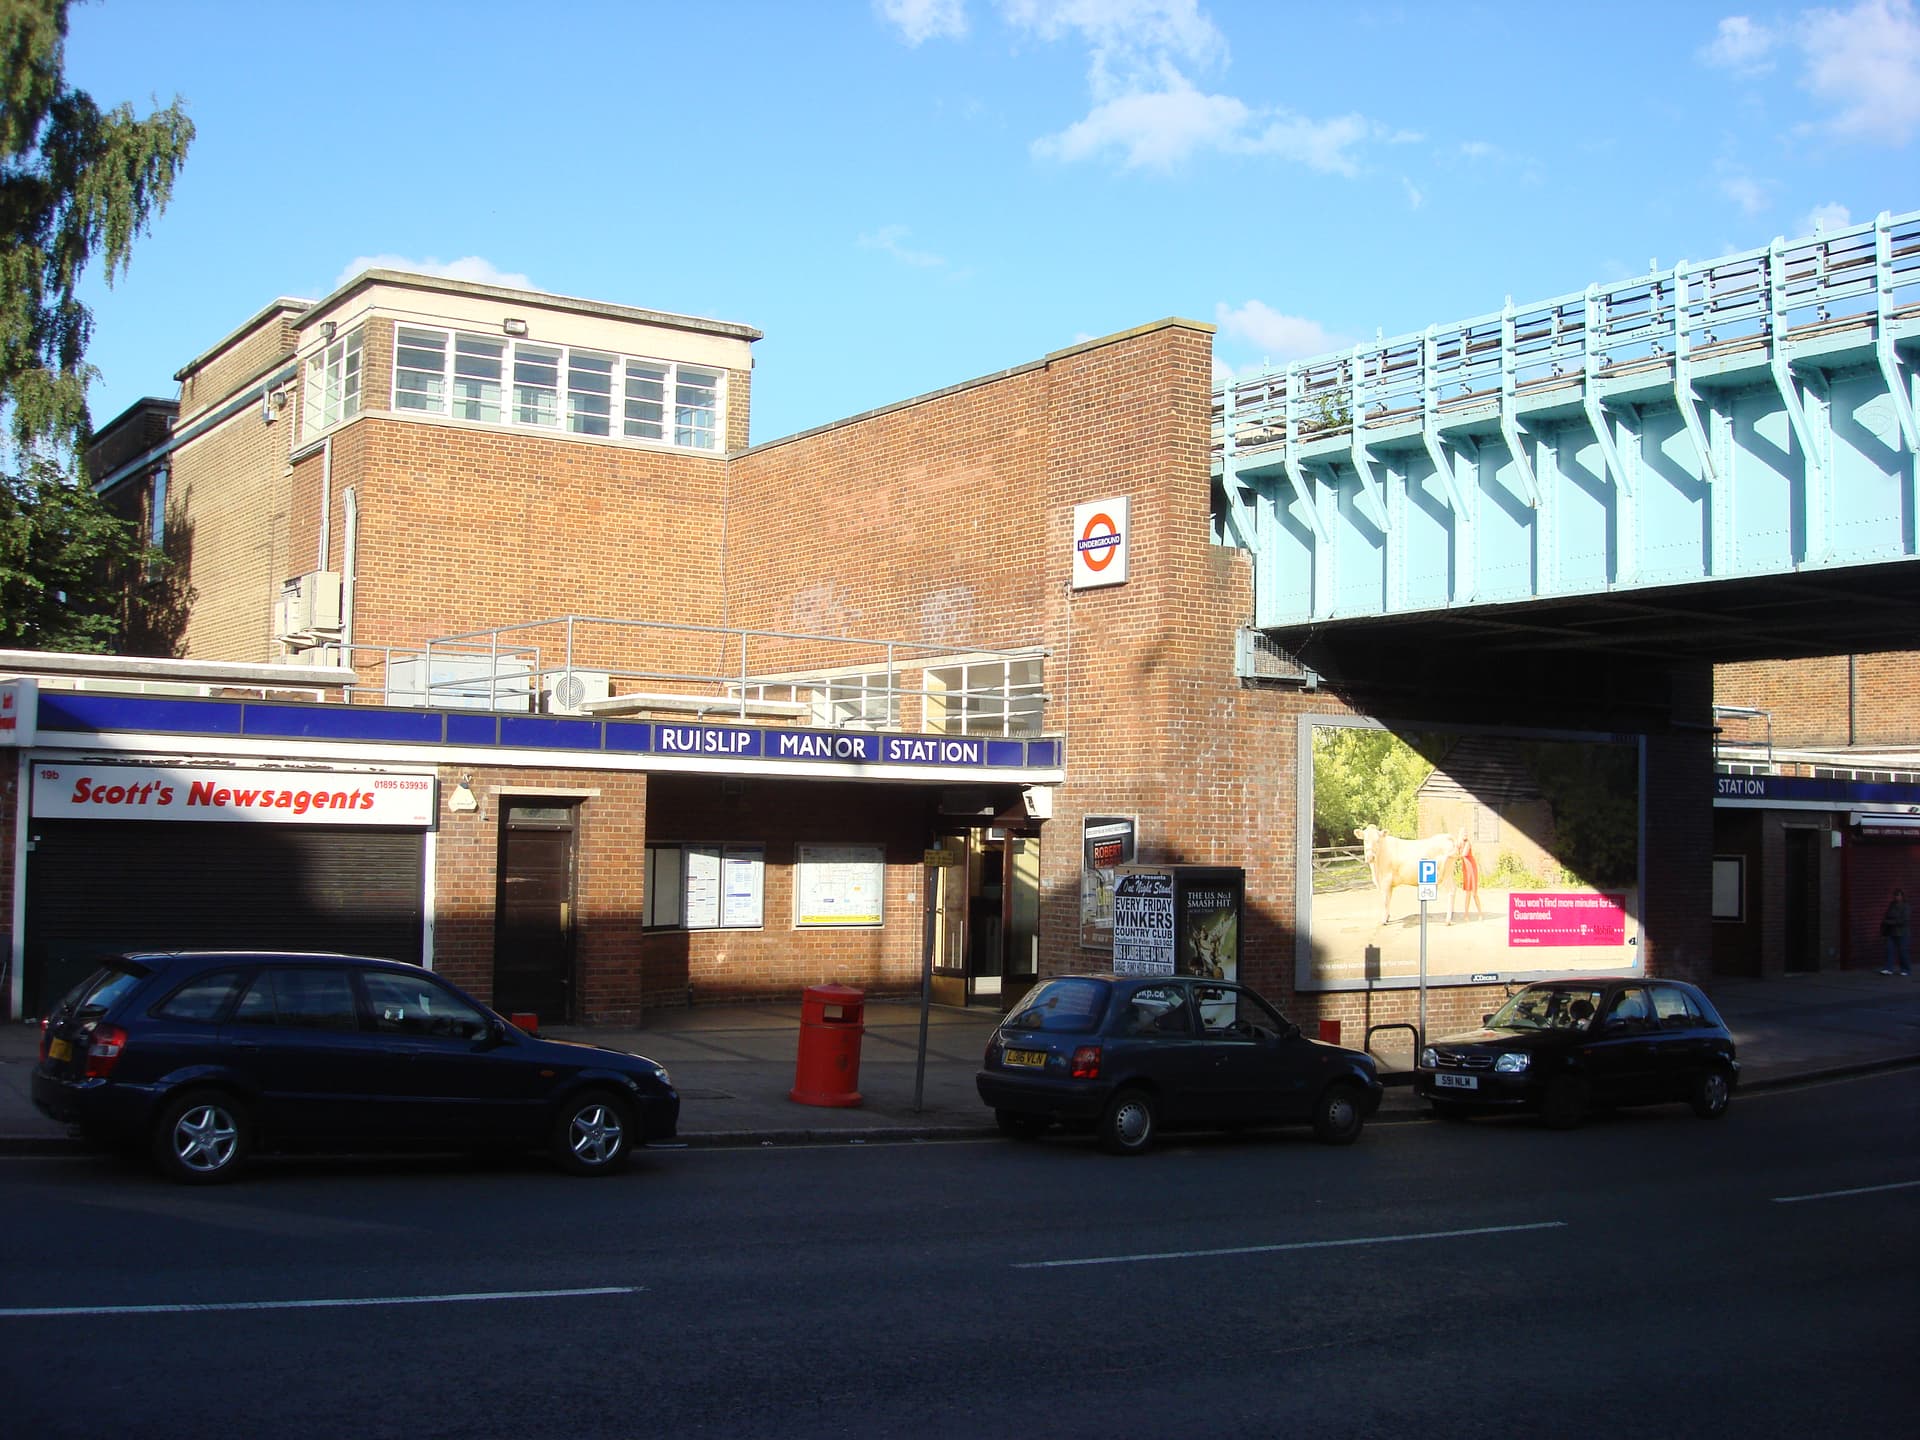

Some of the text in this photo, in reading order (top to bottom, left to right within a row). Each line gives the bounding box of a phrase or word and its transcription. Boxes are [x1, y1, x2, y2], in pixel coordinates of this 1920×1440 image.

[1079, 535, 1120, 549] UNDERGROUND
[662, 728, 978, 762] RUISLIP MANOR STATION
[40, 770, 60, 780] 19b
[374, 780, 429, 790] 01895 639936
[1718, 779, 1764, 794] STATION
[71, 777, 375, 814] Scott's Newsagents
[1095, 844, 1121, 858] ROBERT
[1422, 862, 1435, 882] P
[1187, 892, 1203, 900] THE
[1514, 897, 1525, 908] You
[1545, 897, 1557, 908] find
[1558, 899, 1574, 908] more
[1575, 898, 1598, 908] minutes
[1600, 898, 1608, 908] for
[1115, 898, 1172, 912] EVERY FRIDAY
[1187, 899, 1231, 908] SMASH HIT
[1115, 911, 1173, 929] WINKERS
[1514, 910, 1552, 921] Guaranteed.
[1115, 927, 1150, 938] COUNTRY
[1152, 929, 1173, 939] CLUB
